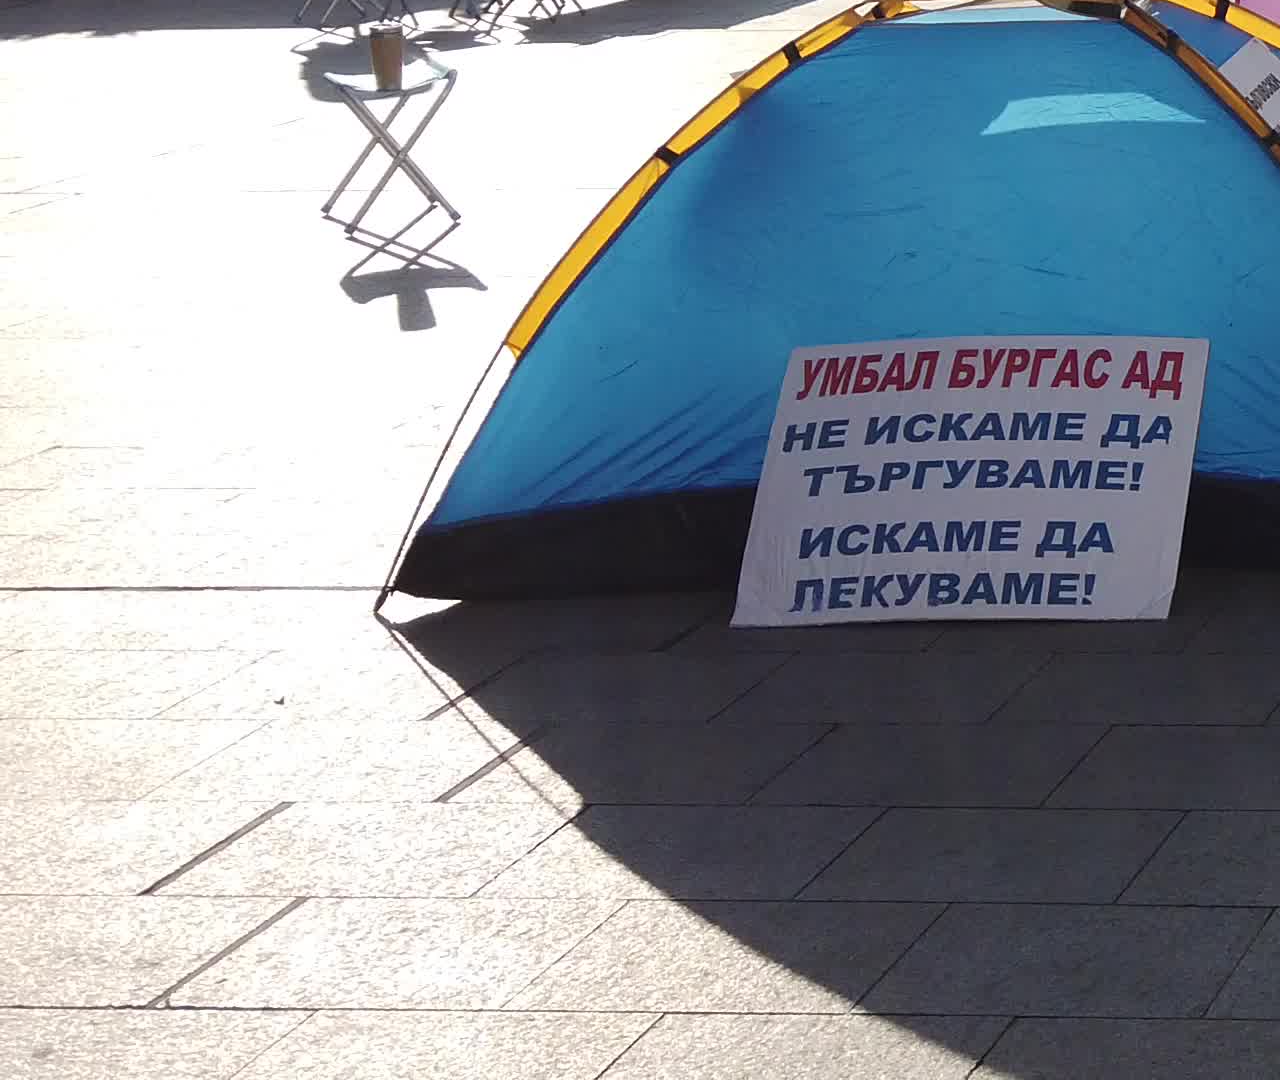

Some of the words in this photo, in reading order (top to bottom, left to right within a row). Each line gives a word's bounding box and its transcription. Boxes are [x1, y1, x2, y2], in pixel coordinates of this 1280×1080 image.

[796, 350, 941, 401] УМБАЛ
[947, 348, 1113, 390] БУРГАС
[1121, 351, 1185, 400] АД
[782, 418, 850, 453] НЕ
[863, 412, 1088, 445] ИСКАМЕ
[1100, 414, 1173, 449] ДА
[803, 459, 1145, 497] ТЪРГУВАМЕ!
[797, 520, 1022, 560] ИСКАМЕ
[1035, 521, 1115, 558] ДА
[788, 573, 1097, 612] ЛЕКУВАМЕ!
